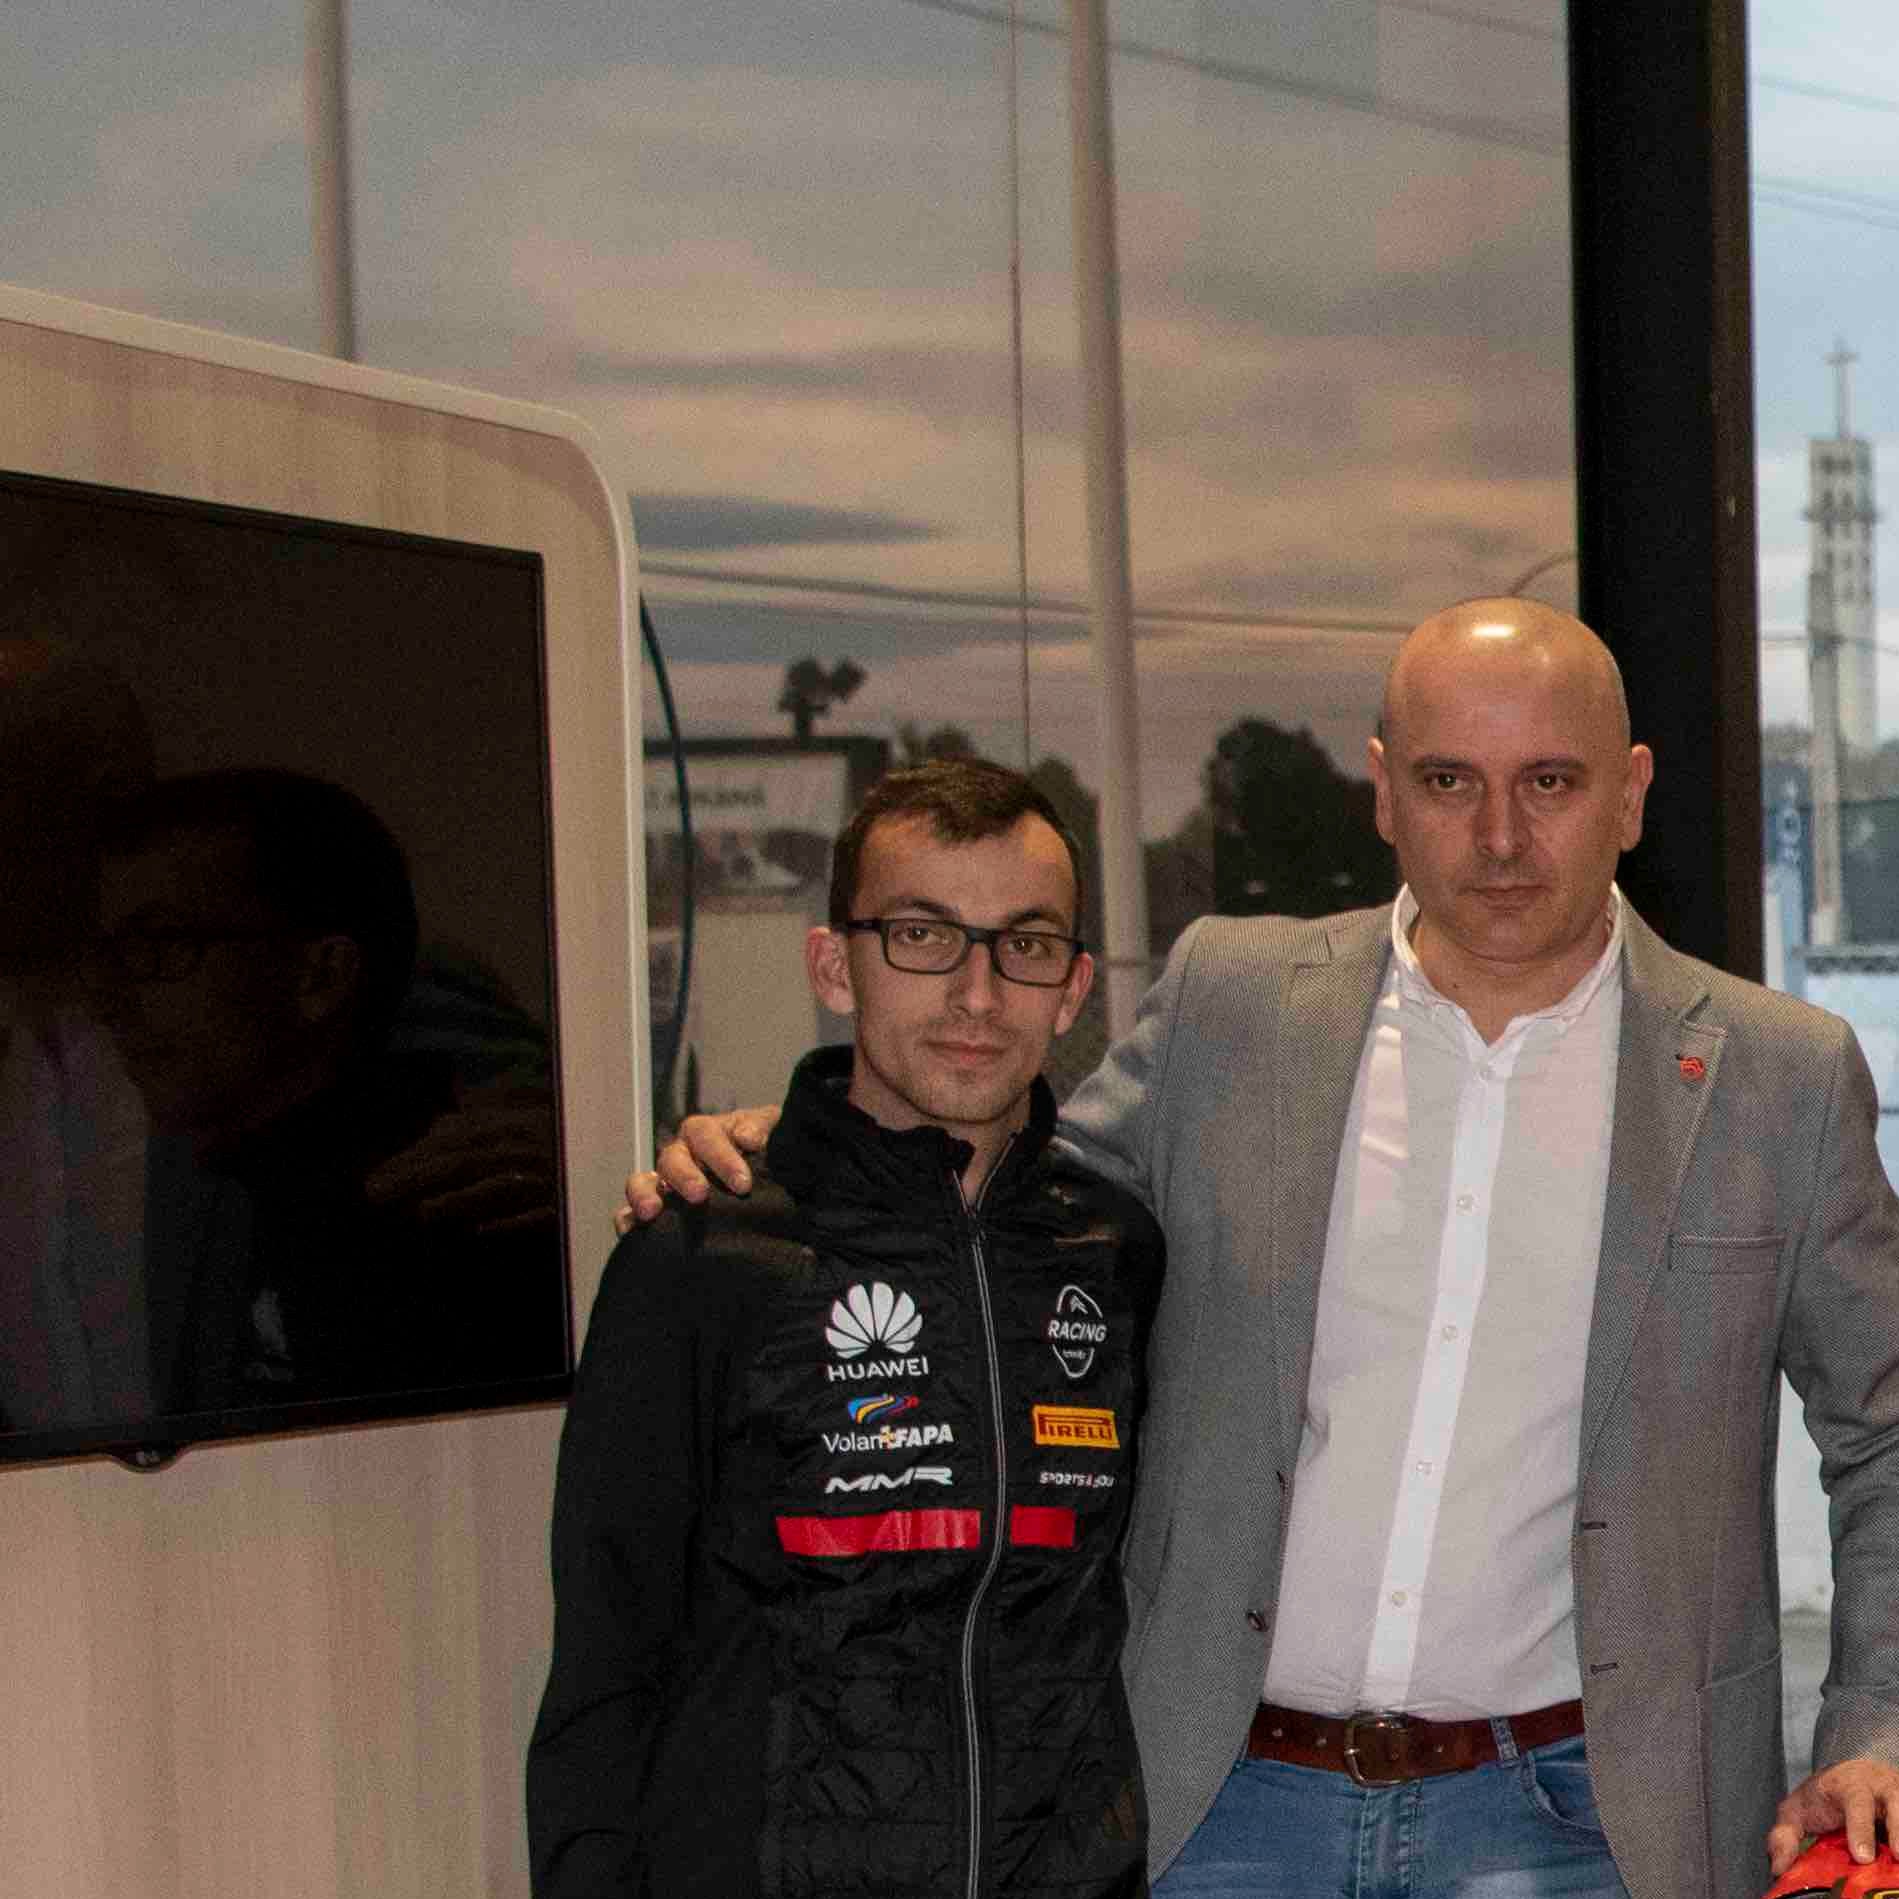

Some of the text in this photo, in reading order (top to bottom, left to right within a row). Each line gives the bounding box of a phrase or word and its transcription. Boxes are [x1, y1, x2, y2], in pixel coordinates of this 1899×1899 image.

[1047, 1319, 1107, 1342] RACING
[827, 1355, 929, 1383] HUAWEI
[1038, 1413, 1114, 1442] PIRELLI
[824, 1465, 954, 1494] MMR
